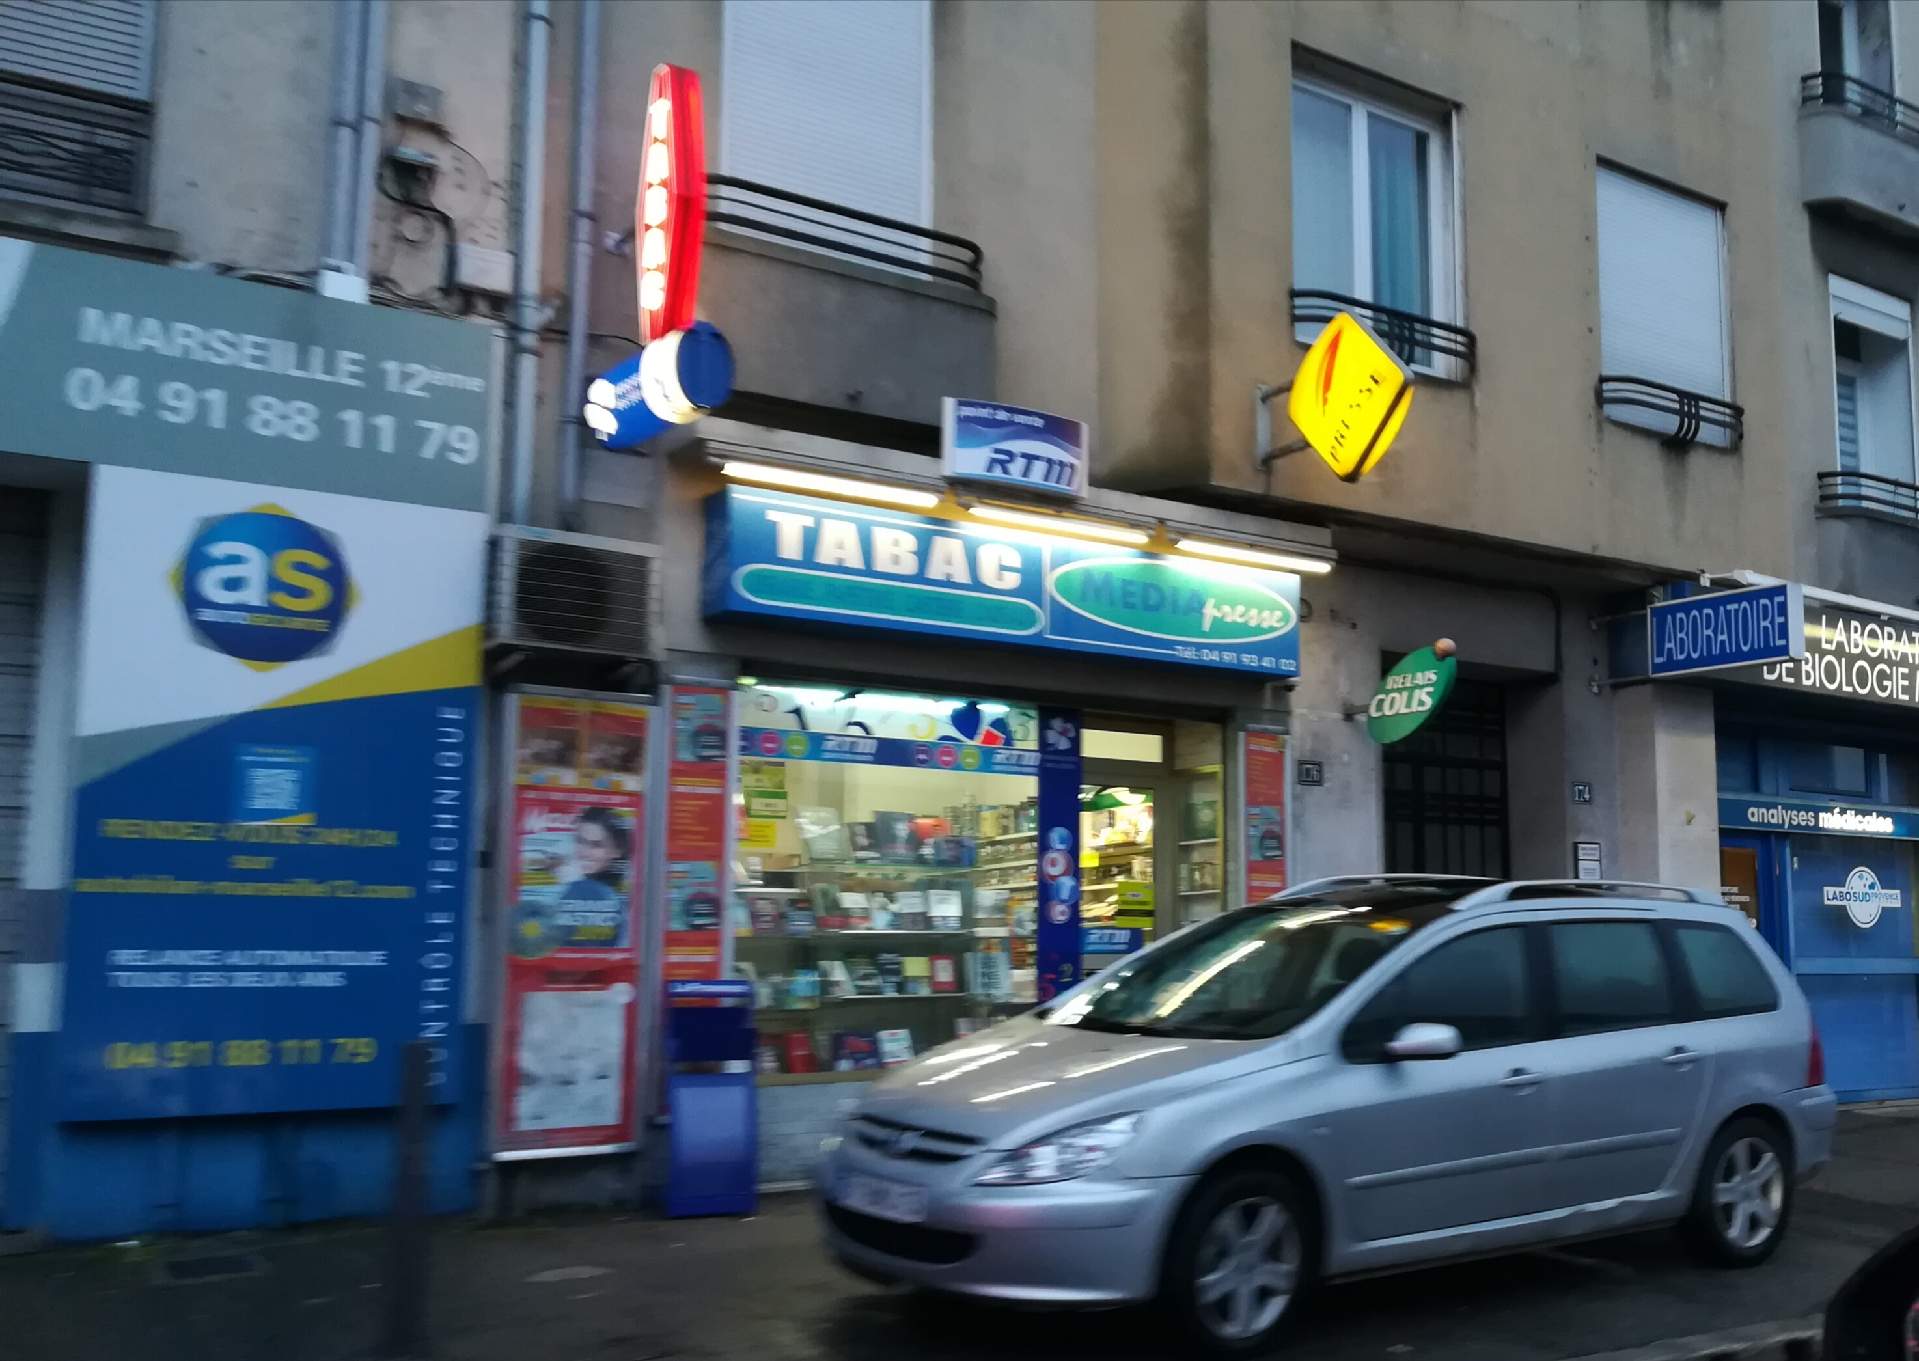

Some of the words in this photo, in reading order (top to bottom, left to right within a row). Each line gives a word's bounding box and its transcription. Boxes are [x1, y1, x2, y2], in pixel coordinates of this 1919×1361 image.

[77, 306, 366, 388] MARSEILLE
[65, 367, 144, 417] 04
[154, 381, 229, 429] 91
[245, 394, 321, 443] 88
[336, 408, 397, 454] 11
[413, 419, 481, 465] 79
[195, 541, 333, 612] as
[765, 509, 1022, 590] TABAC
[1653, 595, 1786, 664] LABORATOIRE
[1369, 687, 1434, 718] COLIS
[1386, 669, 1438, 690] RELAIS
[1801, 651, 1910, 701] BIOLOGIE
[426, 706, 466, 894] TECHNIQUE
[1747, 805, 1815, 830] analyses
[1818, 806, 1894, 833] médicales
[104, 1041, 158, 1070] 04
[162, 1040, 214, 1069] 91
[218, 1039, 273, 1067] 88
[276, 1038, 323, 1065] 11
[326, 1037, 379, 1064] 79
